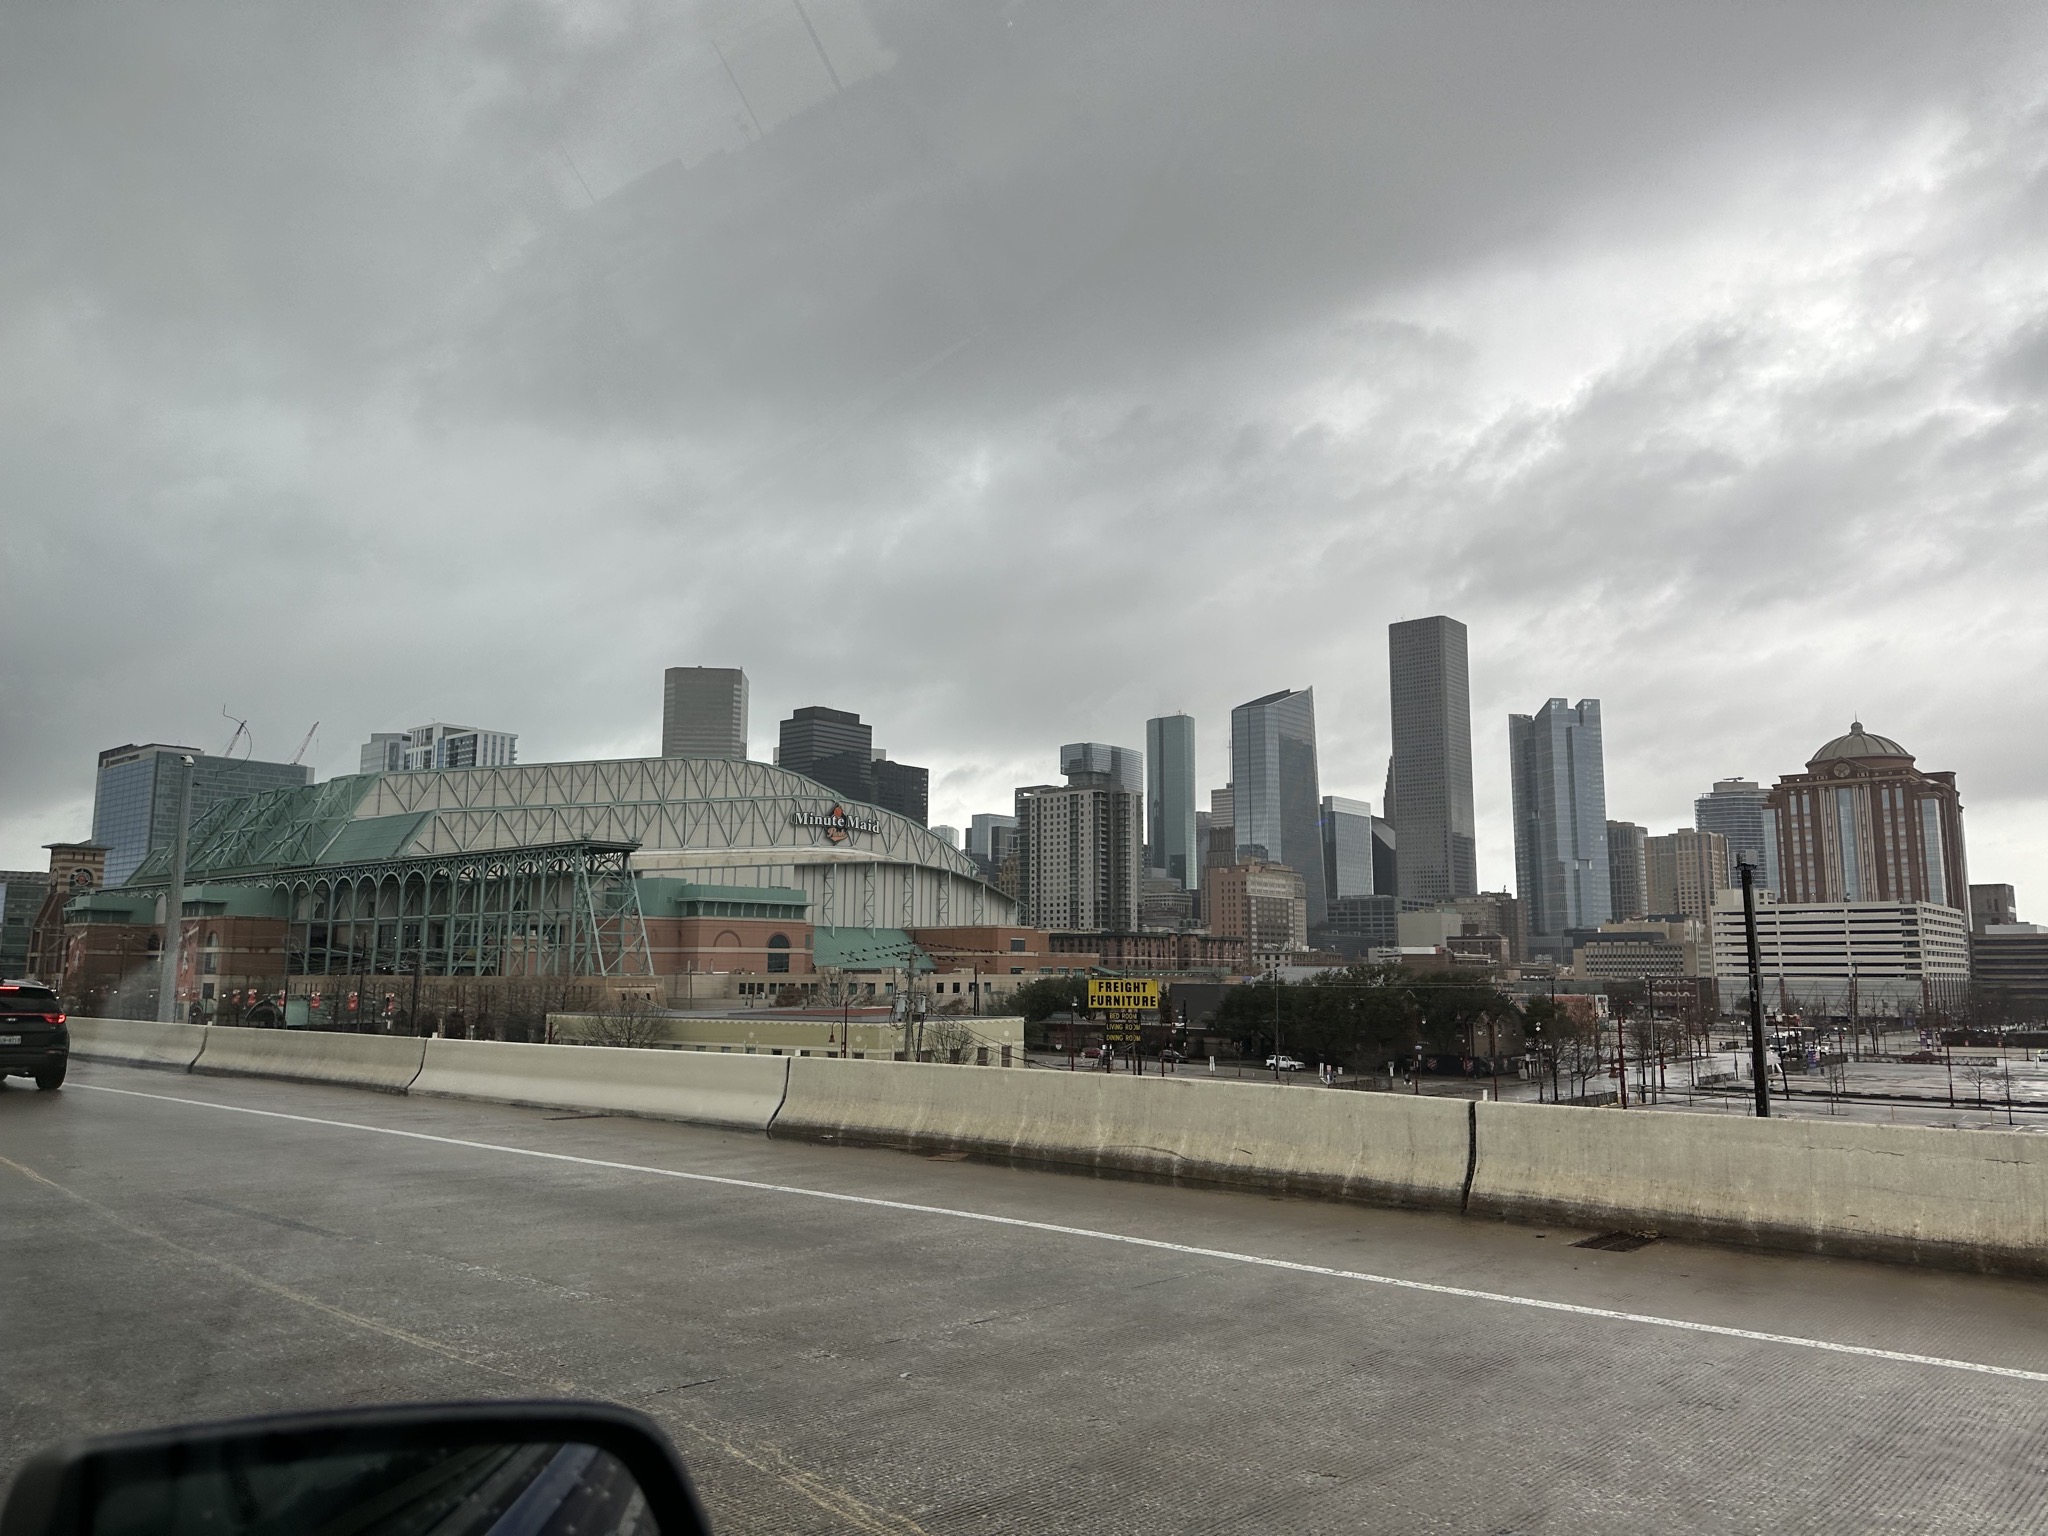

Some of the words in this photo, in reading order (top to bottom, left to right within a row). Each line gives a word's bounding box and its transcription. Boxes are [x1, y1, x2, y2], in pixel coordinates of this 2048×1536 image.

[794, 812, 845, 827] Minute
[847, 815, 880, 834] Maid
[1098, 982, 1148, 993] FREIGHT
[1090, 995, 1156, 1007] FURNITURE
[1109, 1012, 1120, 1020] BED
[1121, 1012, 1137, 1020] ROOM
[1106, 1023, 1123, 1031] LIVING
